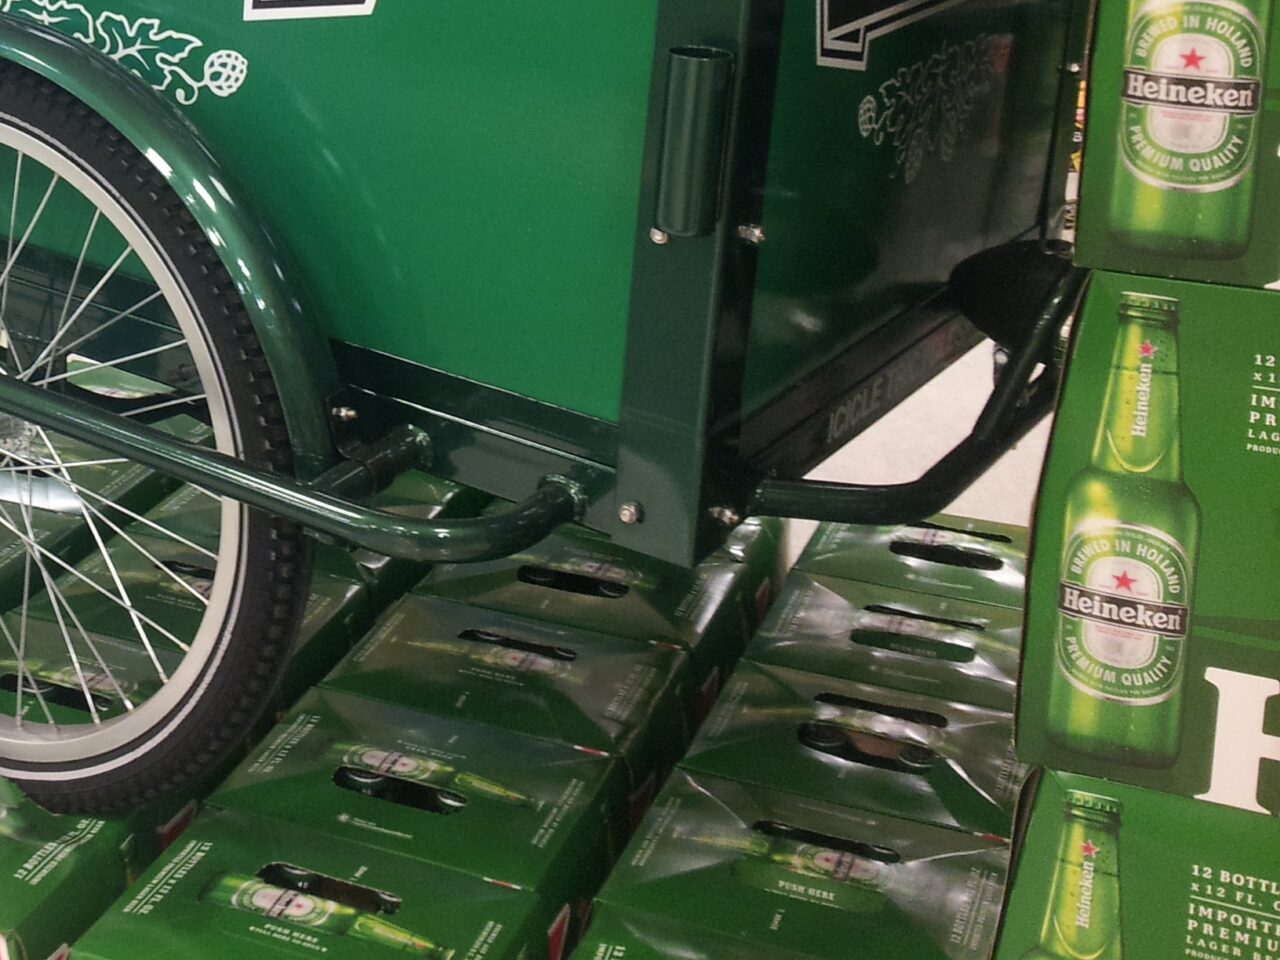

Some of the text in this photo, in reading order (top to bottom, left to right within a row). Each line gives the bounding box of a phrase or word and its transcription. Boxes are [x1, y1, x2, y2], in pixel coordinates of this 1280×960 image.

[1135, 14, 1253, 68] BREWED IN HOLLAND
[1125, 73, 1254, 108] Heineken
[1129, 125, 1245, 172] PREMIUM QUALITY
[1254, 353, 1276, 367] 12
[1131, 362, 1153, 438] Heineken
[1071, 536, 1181, 594] BREWED IN HOLLAND
[1063, 587, 1183, 631] Heineken
[1065, 635, 1171, 688] PREMIUM QUALITY
[173, 852, 206, 878] BOTTLES
[1192, 865, 1213, 879] 12
[778, 880, 805, 893] PUSH
[808, 887, 835, 901] HERE
[1076, 861, 1096, 929] Heineken
[1236, 891, 1262, 908] FL.
[1186, 935, 1242, 957] LAGER
